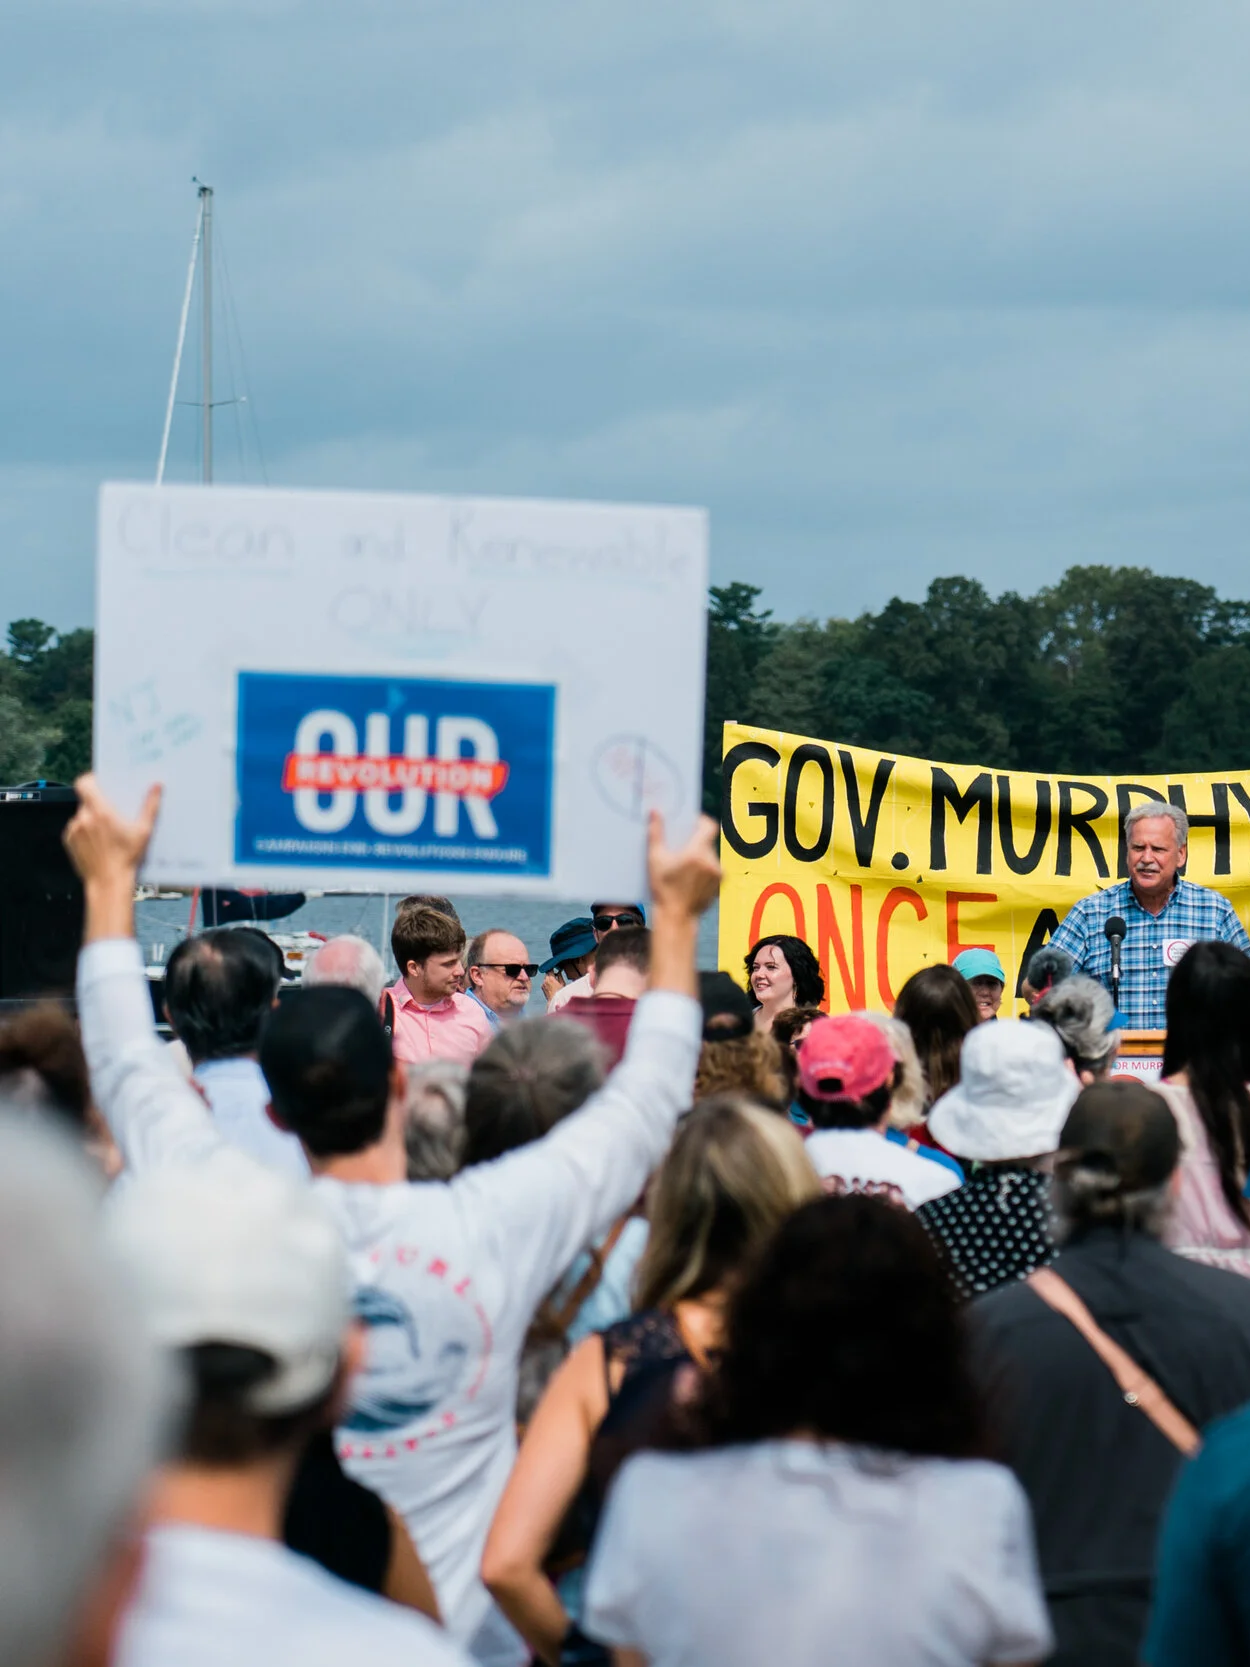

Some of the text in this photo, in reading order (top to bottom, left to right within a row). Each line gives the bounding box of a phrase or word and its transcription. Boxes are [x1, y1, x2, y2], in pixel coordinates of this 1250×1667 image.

[118, 498, 295, 563] Clean
[327, 583, 492, 640] ONLY
[293, 709, 500, 838] OUR
[295, 760, 494, 790] REVOLUTION
[721, 742, 909, 870] GOV.
[1131, 1062, 1163, 1070] MURP
